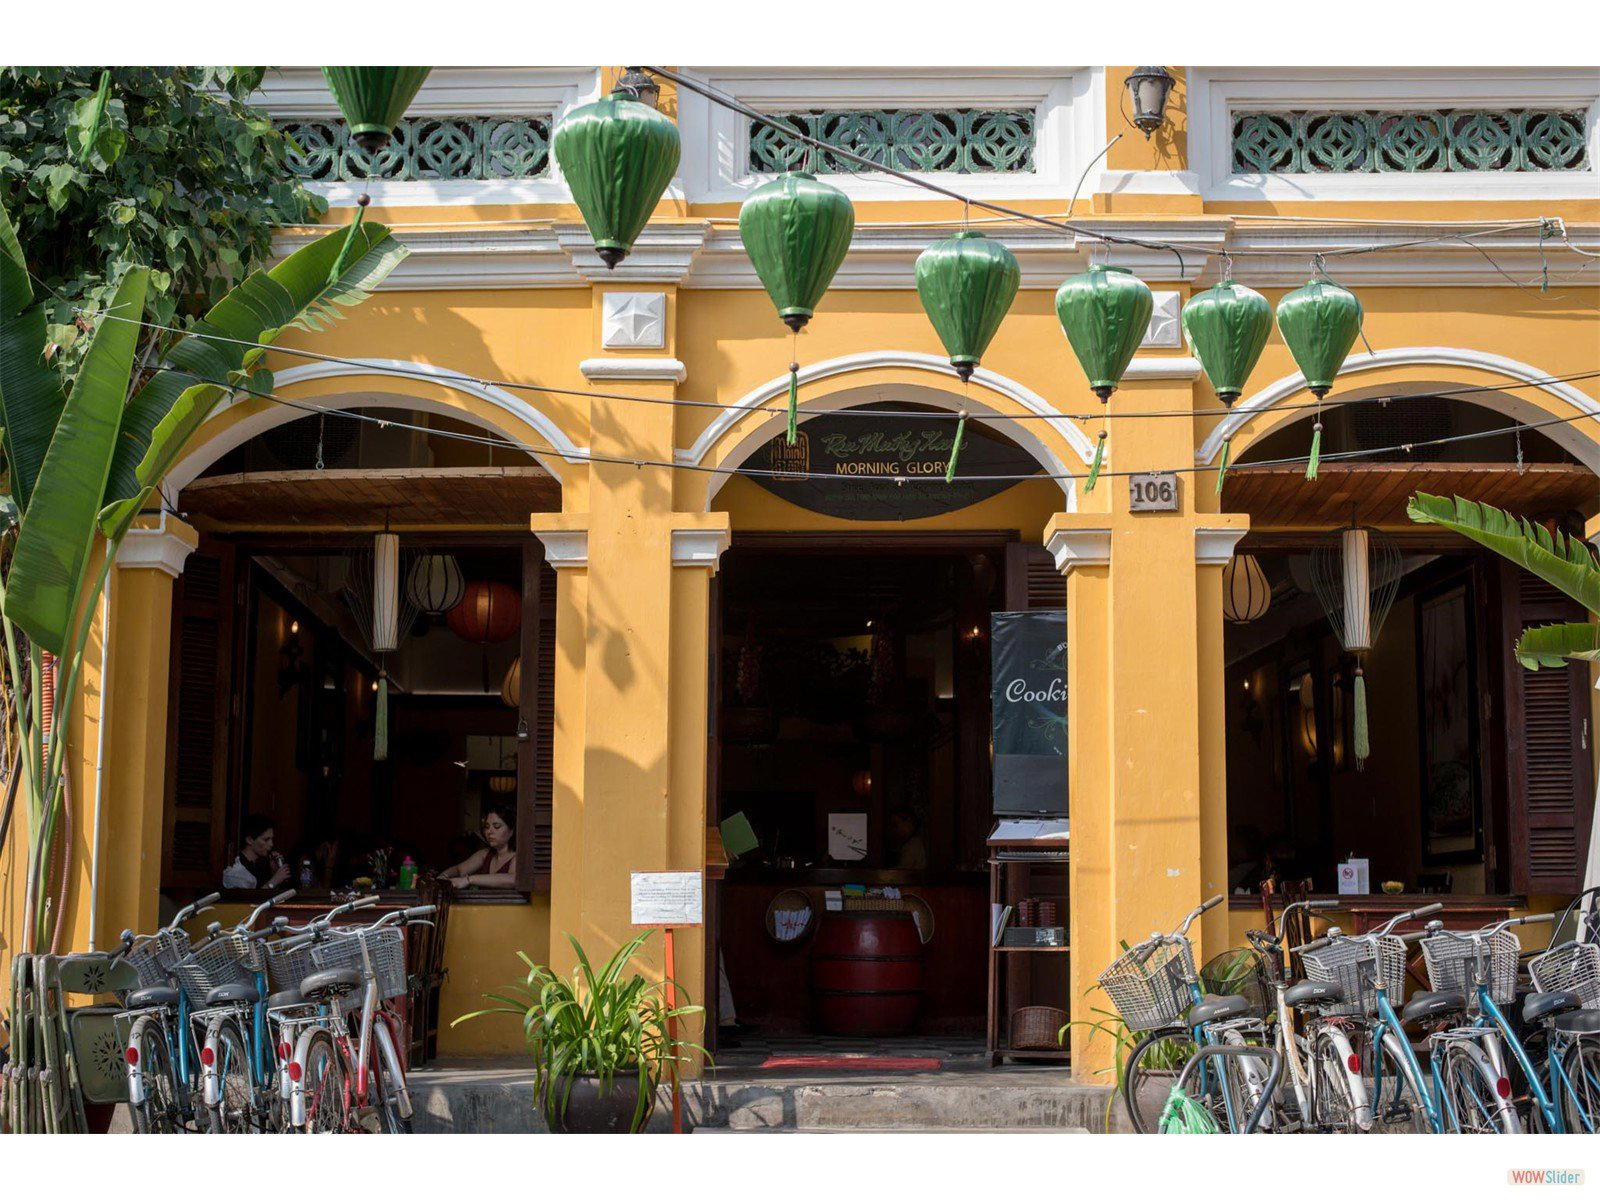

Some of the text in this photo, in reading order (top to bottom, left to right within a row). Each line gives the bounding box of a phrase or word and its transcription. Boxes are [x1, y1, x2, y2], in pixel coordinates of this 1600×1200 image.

[836, 461, 950, 475] MORNING GLORY
[1134, 481, 1173, 502] 106
